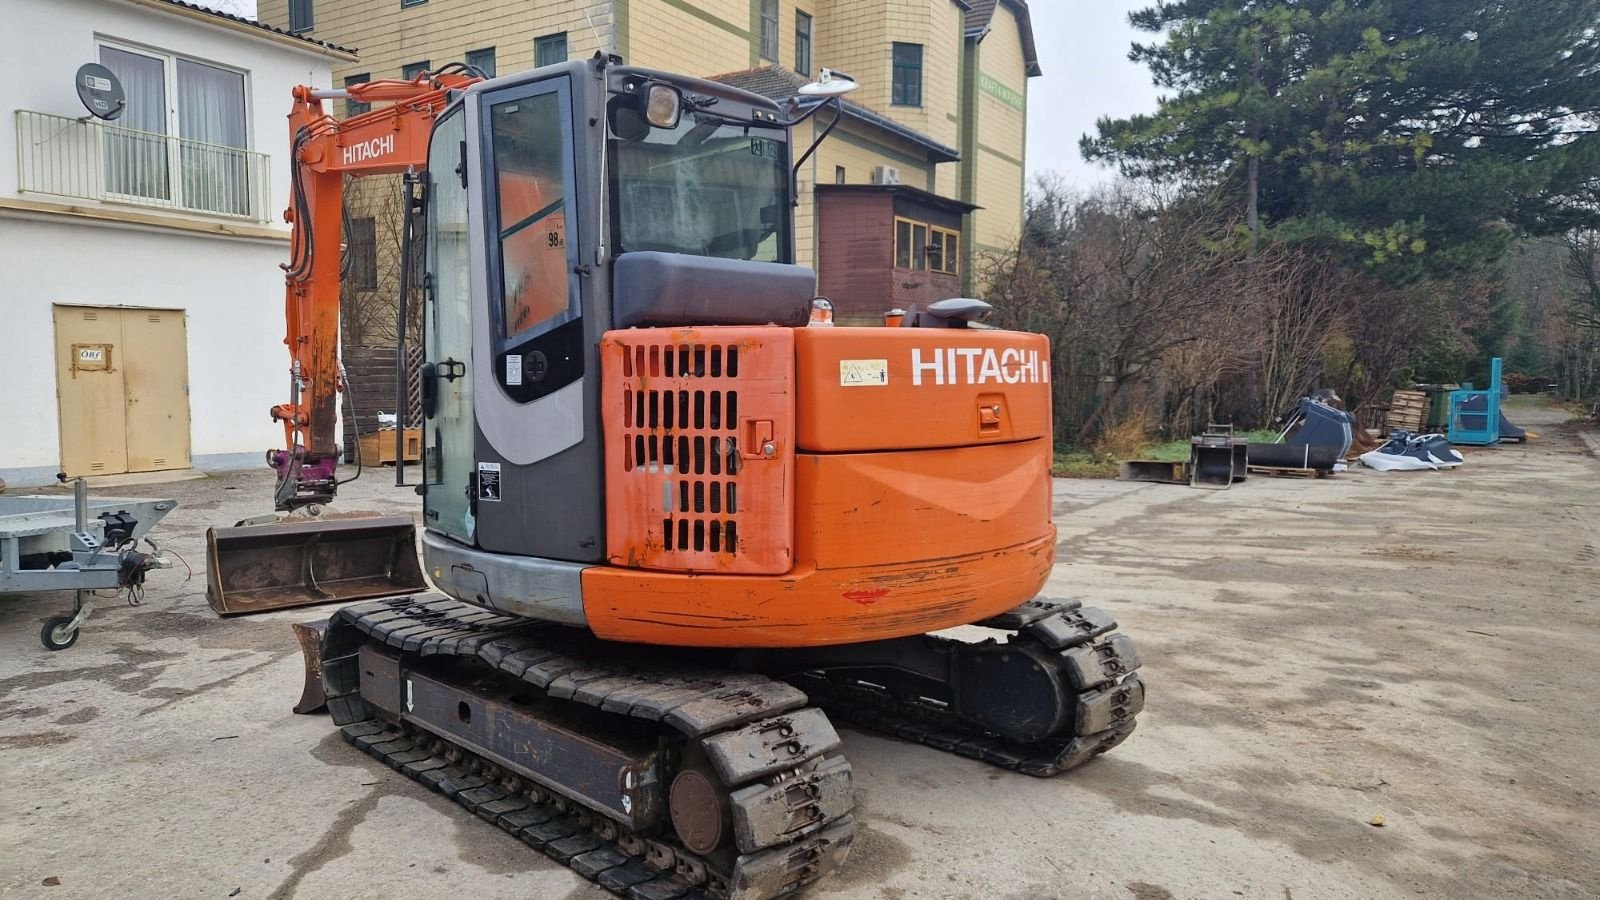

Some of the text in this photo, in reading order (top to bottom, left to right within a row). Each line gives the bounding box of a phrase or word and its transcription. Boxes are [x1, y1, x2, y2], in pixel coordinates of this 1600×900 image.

[343, 134, 394, 165] HITACHI
[548, 232, 558, 247] 98
[911, 348, 1039, 386] HITACHI
